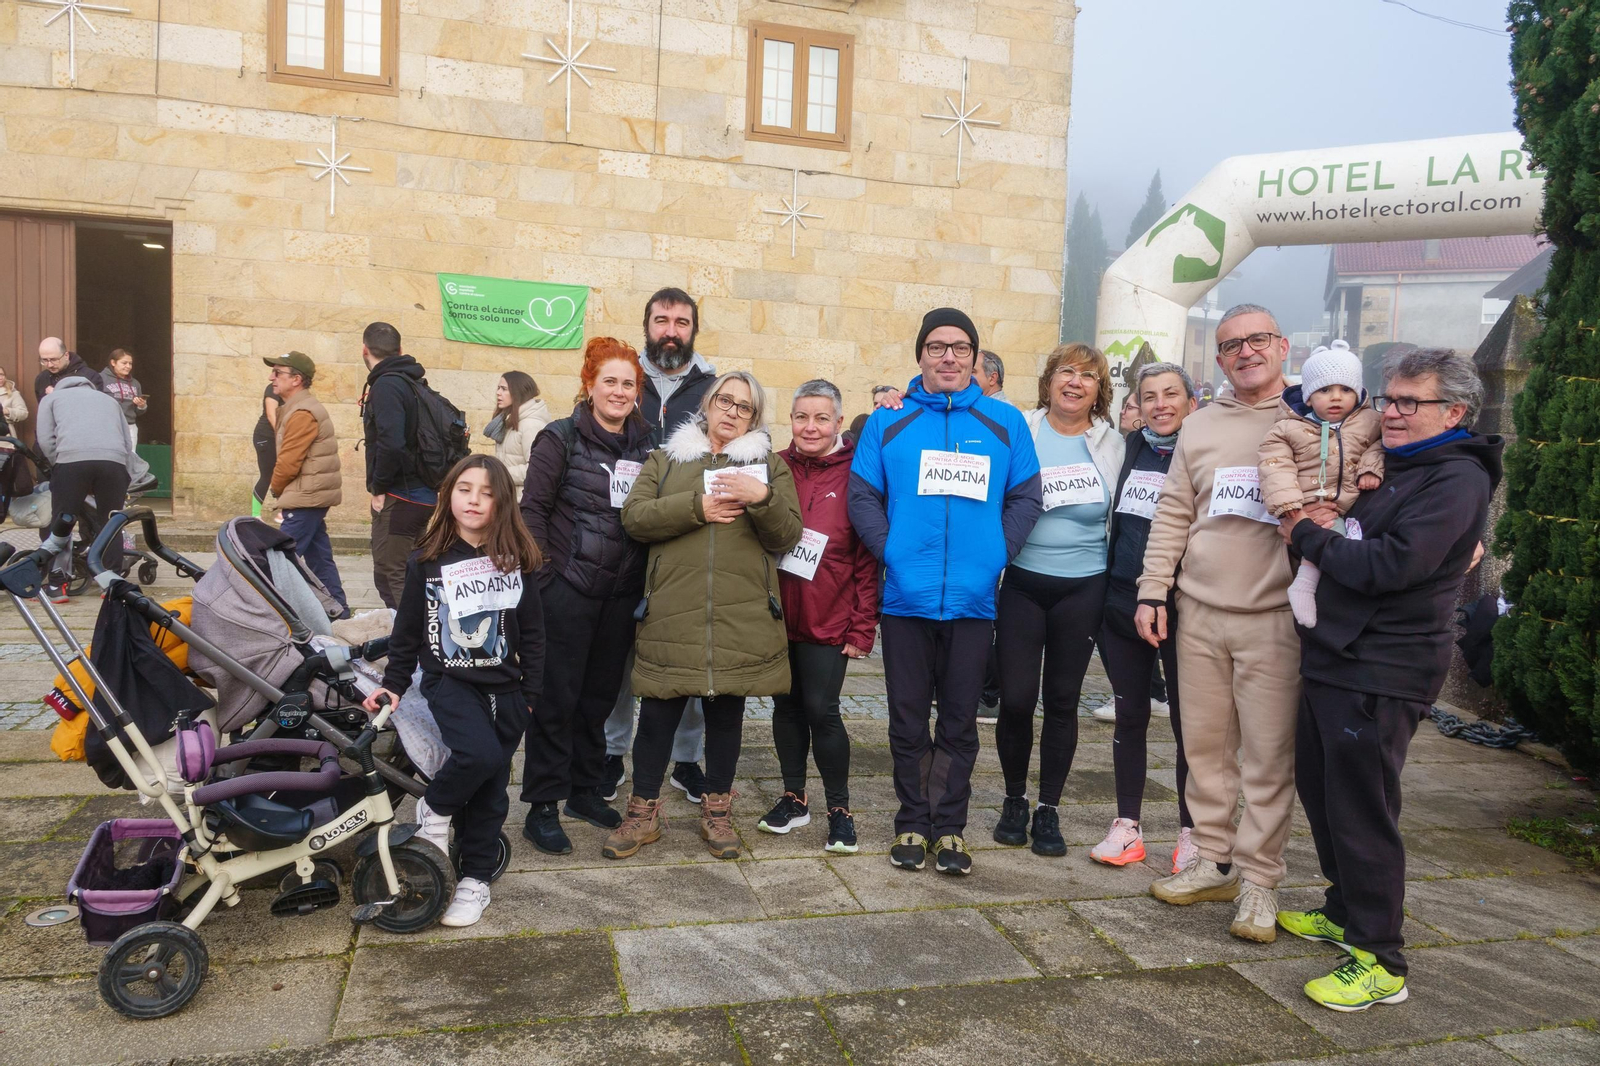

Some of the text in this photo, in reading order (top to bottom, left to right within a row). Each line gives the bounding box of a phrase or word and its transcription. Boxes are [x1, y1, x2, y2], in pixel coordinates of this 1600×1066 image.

[1257, 160, 1395, 198] HOTEL
[1426, 152, 1480, 187] LA
[1256, 191, 1522, 223] www.hotelrectoral.com
[447, 301, 525, 315] Contra el cáncer
[480, 314, 500, 322] solo
[925, 468, 986, 486] ANDAINA
[1043, 476, 1100, 496] ANDAINA
[611, 480, 630, 494] AND
[1215, 485, 1264, 504] ANDAI
[787, 546, 818, 565] AINA
[449, 567, 479, 577] CONTRA
[455, 575, 521, 601] ANDAINA
